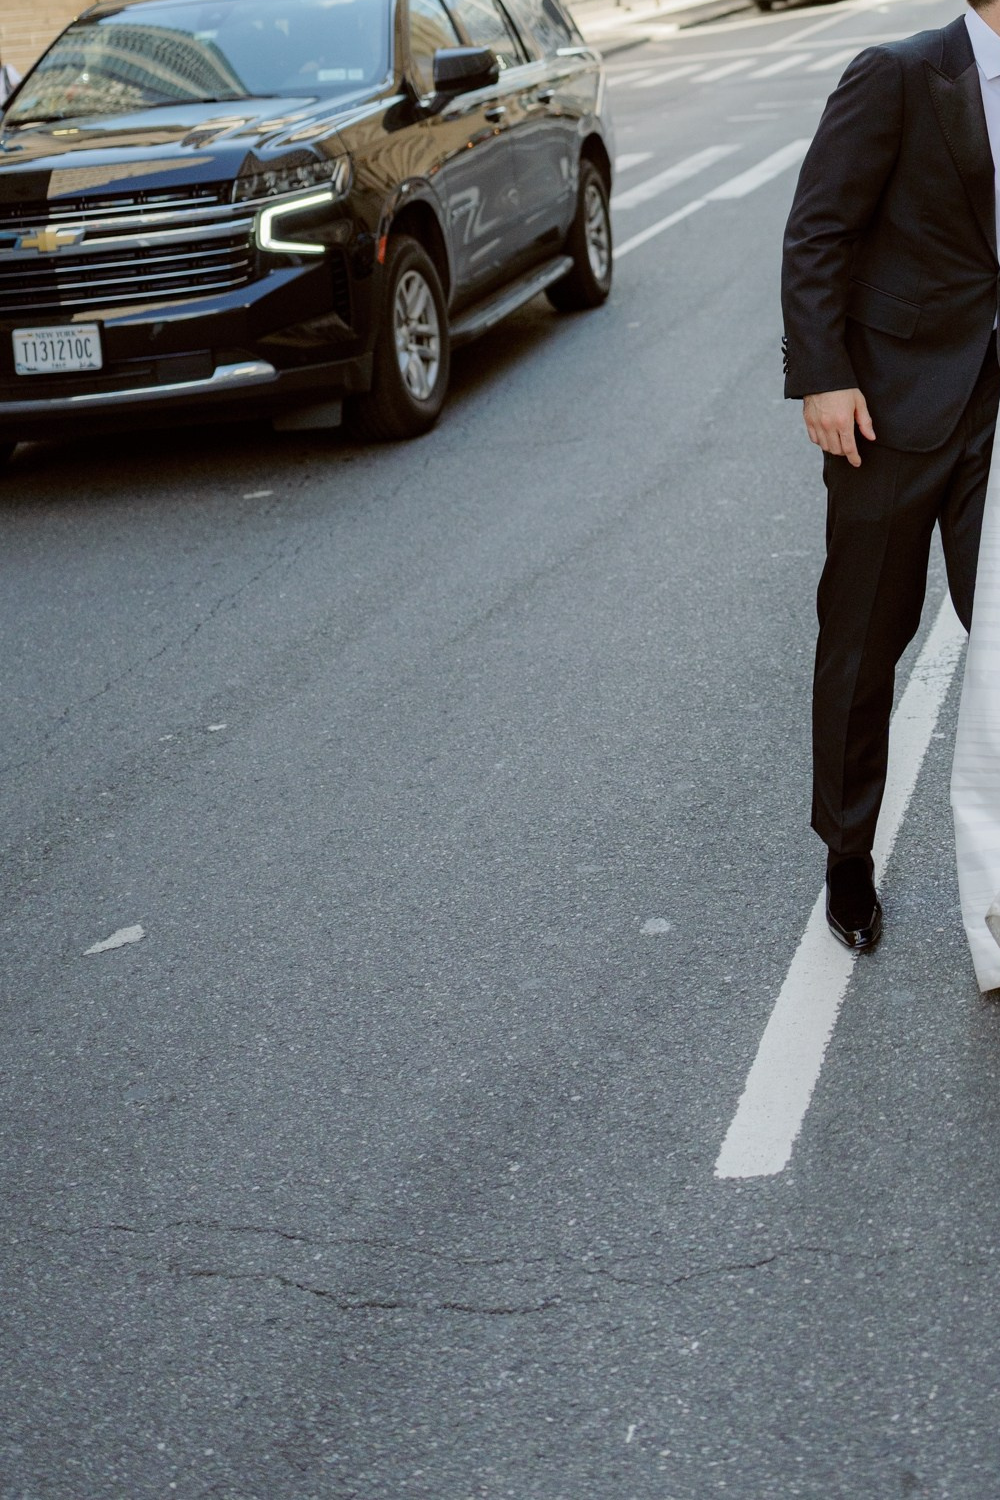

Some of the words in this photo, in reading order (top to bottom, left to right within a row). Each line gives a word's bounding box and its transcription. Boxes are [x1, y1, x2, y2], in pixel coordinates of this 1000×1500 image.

[35, 331, 53, 339] NEW
[55, 330, 77, 338] YORK
[22, 338, 93, 363] T131210C
